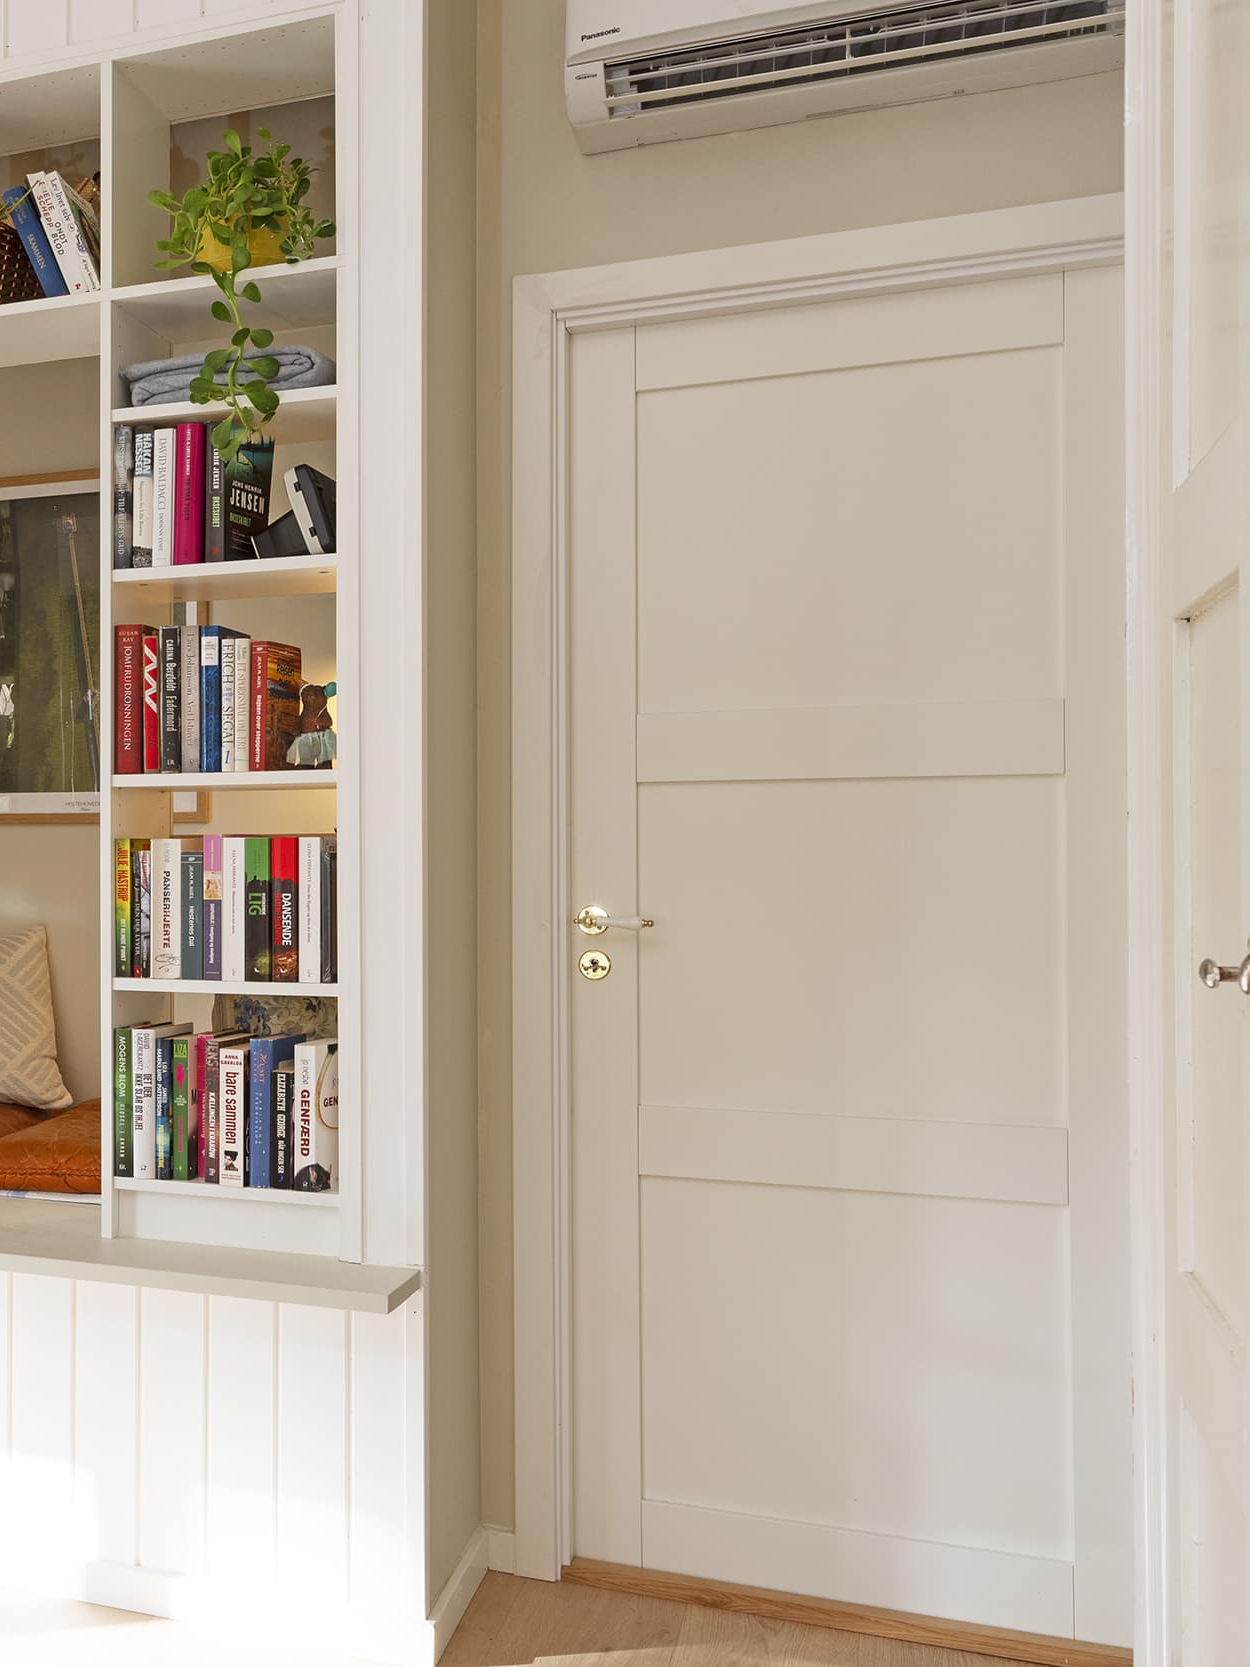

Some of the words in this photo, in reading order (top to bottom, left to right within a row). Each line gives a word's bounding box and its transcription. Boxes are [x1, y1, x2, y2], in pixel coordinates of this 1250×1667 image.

[581, 27, 620, 41] Panasonic
[36, 195, 54, 228] SCHEPP
[51, 232, 65, 256] BLOD
[54, 221, 69, 246] ONDT
[134, 433, 143, 476] NESSER
[141, 433, 153, 475] HÅKAN
[158, 438, 167, 466] DAVID
[212, 447, 220, 466] ENRIK
[157, 467, 167, 511] BALDACCI
[229, 487, 265, 515] JENSEN
[166, 639, 174, 661] CARINA
[222, 644, 234, 684] ERICH
[165, 662, 177, 691] Bergfeldt
[185, 654, 196, 696] Johansson
[123, 645, 133, 751] JOMFRUDRONNINGEN
[165, 695, 177, 732] Fadermord
[222, 705, 234, 747] SEGAL
[254, 715, 262, 729] over
[117, 847, 129, 866] JULIE
[117, 869, 129, 902] HASTRUP
[162, 870, 171, 948] PANSERHJERTE
[188, 905, 196, 935] Hestenes
[247, 892, 262, 916] LIG
[281, 892, 292, 946] DANSENDE
[136, 1032, 144, 1071] LAGERCRANTZ
[135, 1073, 143, 1087] IKKE
[143, 1073, 152, 1085] DET
[143, 1086, 152, 1098] DER
[225, 1072, 239, 1095] bare
[276, 1073, 287, 1111] ELIZABETH
[208, 1092, 216, 1127] KÆLLINGEN
[225, 1098, 238, 1144] sammen
[277, 1113, 286, 1138] GEORGE
[300, 1089, 310, 1157] GENFÆRD
